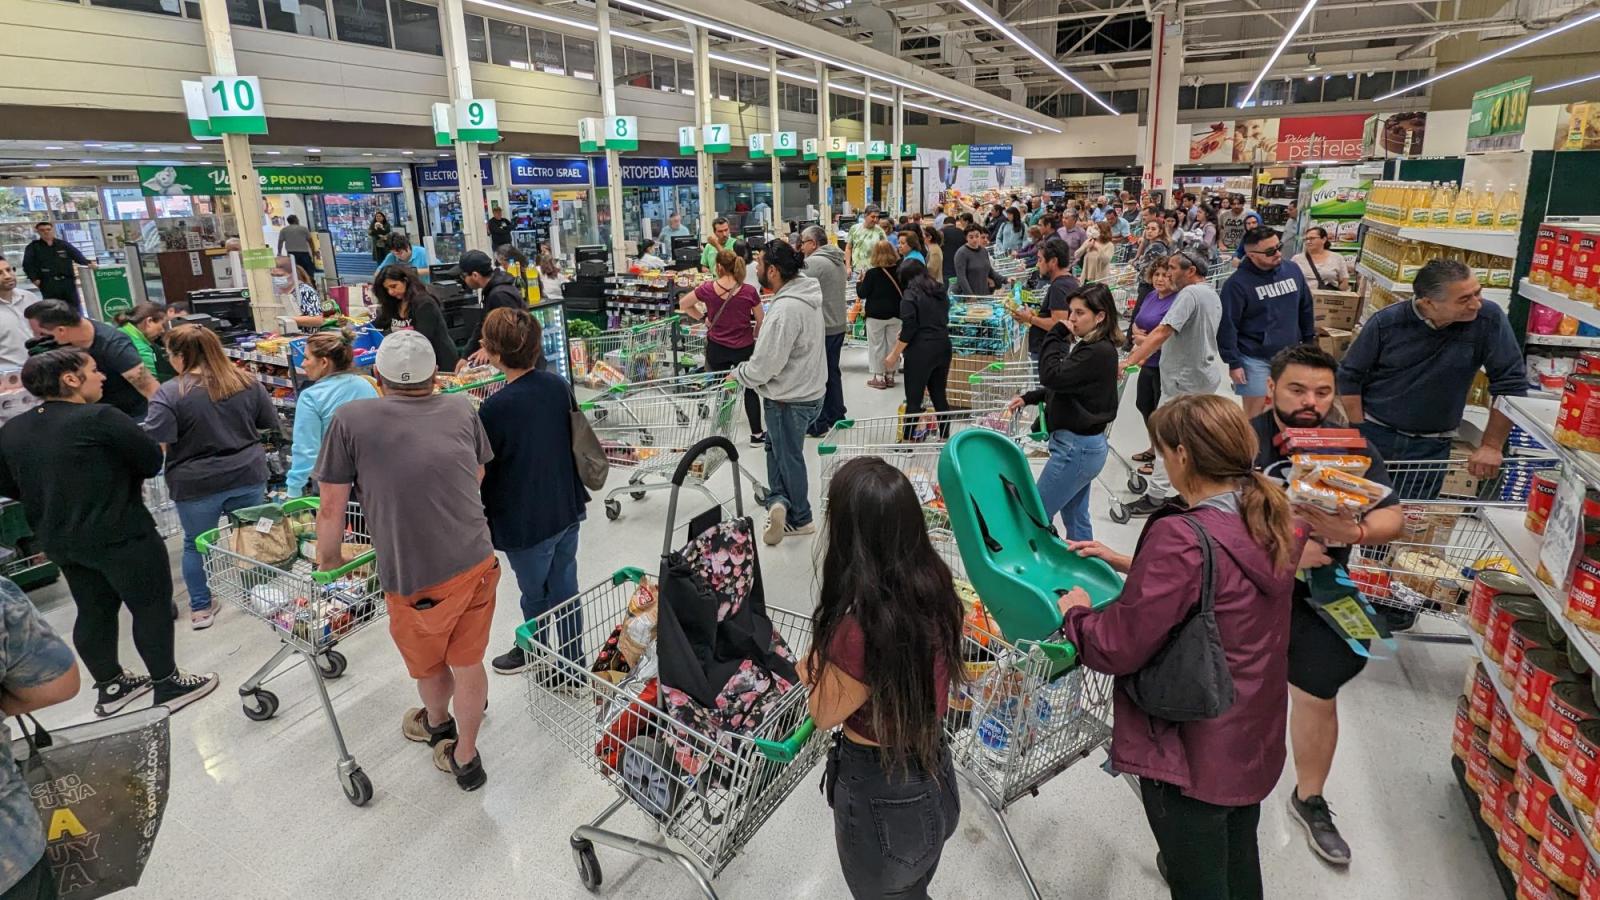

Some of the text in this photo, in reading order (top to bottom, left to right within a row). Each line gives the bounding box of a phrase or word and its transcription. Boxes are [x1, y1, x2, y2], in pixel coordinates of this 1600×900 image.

[211, 79, 256, 112] 10
[468, 102, 484, 126] 9
[580, 122, 586, 140] 8
[615, 118, 628, 137] 8
[711, 127, 722, 142] 7
[780, 133, 789, 147] 6
[806, 140, 812, 152] 5
[832, 138, 840, 150] 5
[871, 143, 879, 153] 4
[904, 144, 911, 155] 3
[1289, 140, 1364, 161] pasteles
[424, 171, 458, 181] ELECTRO
[517, 166, 582, 178] ELECTRO ISRAEL
[671, 166, 699, 179] ISRAEL
[270, 175, 323, 185] PRONTO
[1255, 278, 1298, 300] PUMA
[48, 808, 88, 841] A
